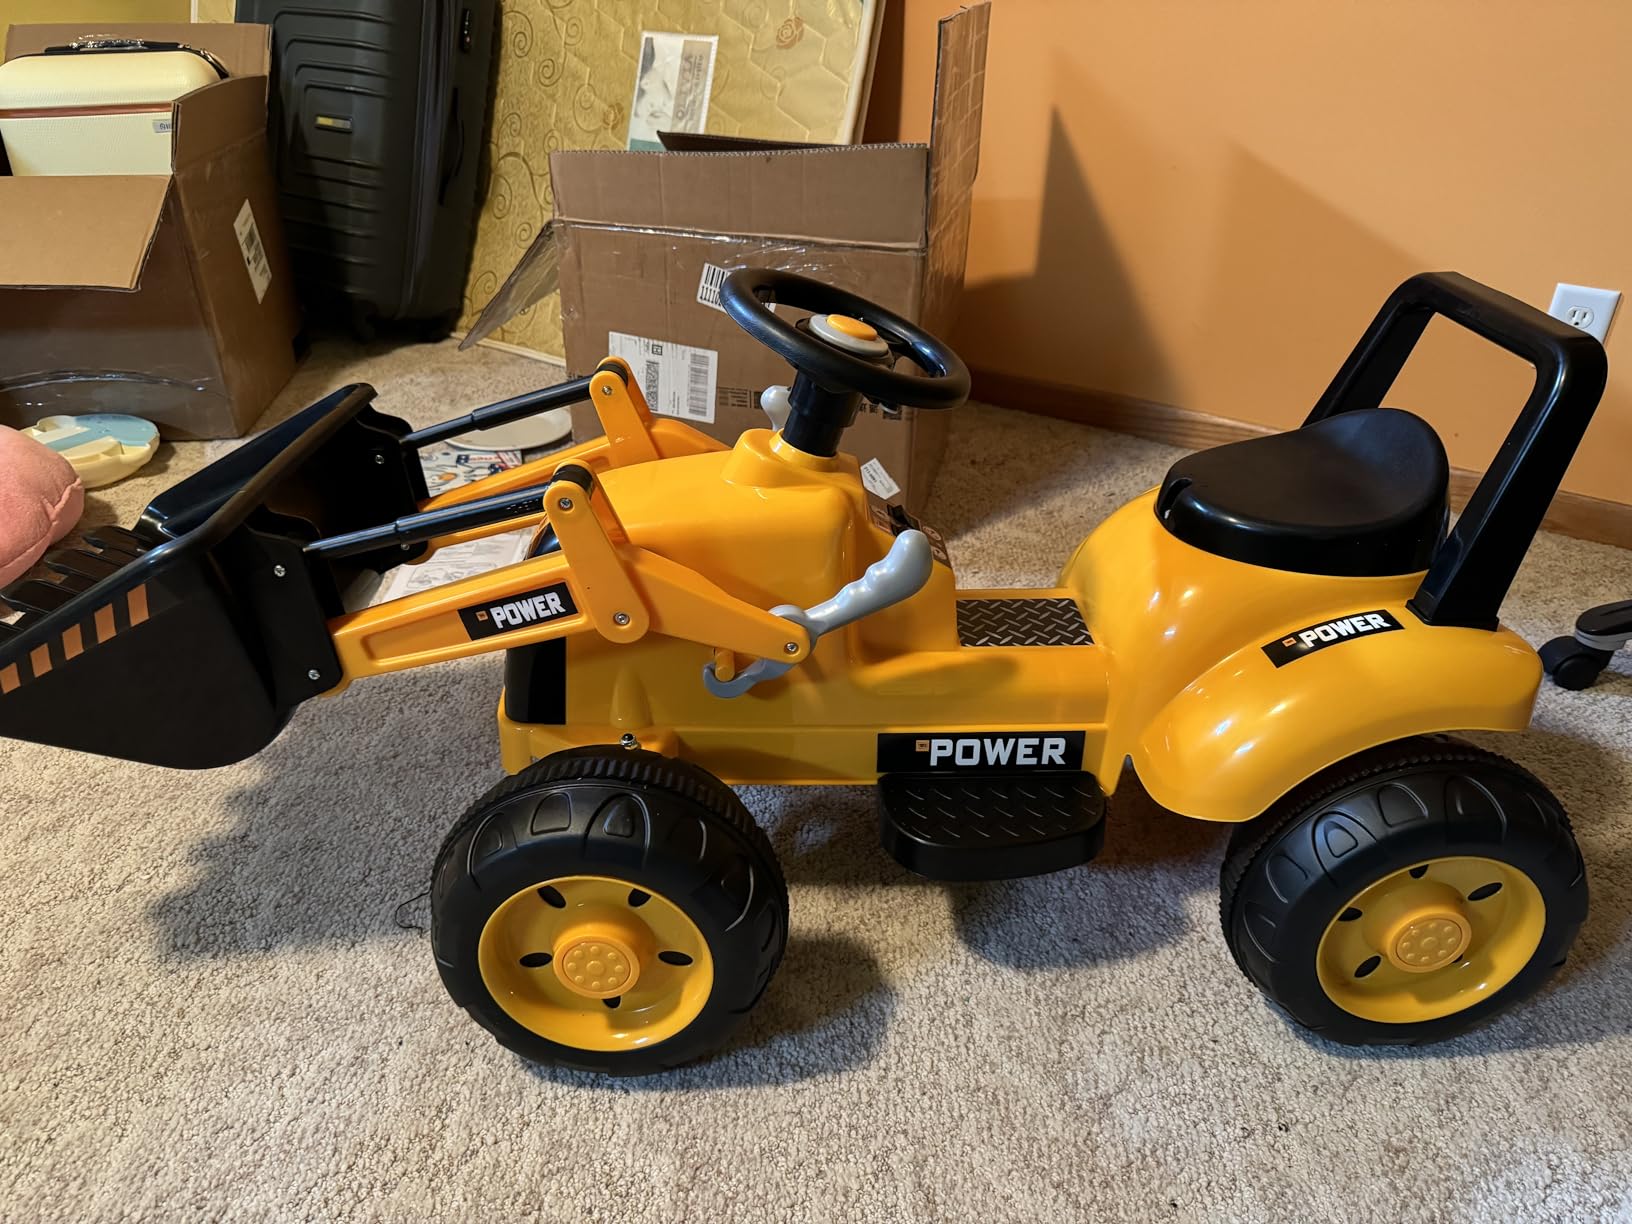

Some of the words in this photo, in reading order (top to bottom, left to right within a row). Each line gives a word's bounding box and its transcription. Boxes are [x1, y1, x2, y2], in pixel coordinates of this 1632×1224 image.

[490, 592, 566, 629] POWER
[1299, 613, 1392, 648] POWER
[930, 737, 1066, 767] POWER
